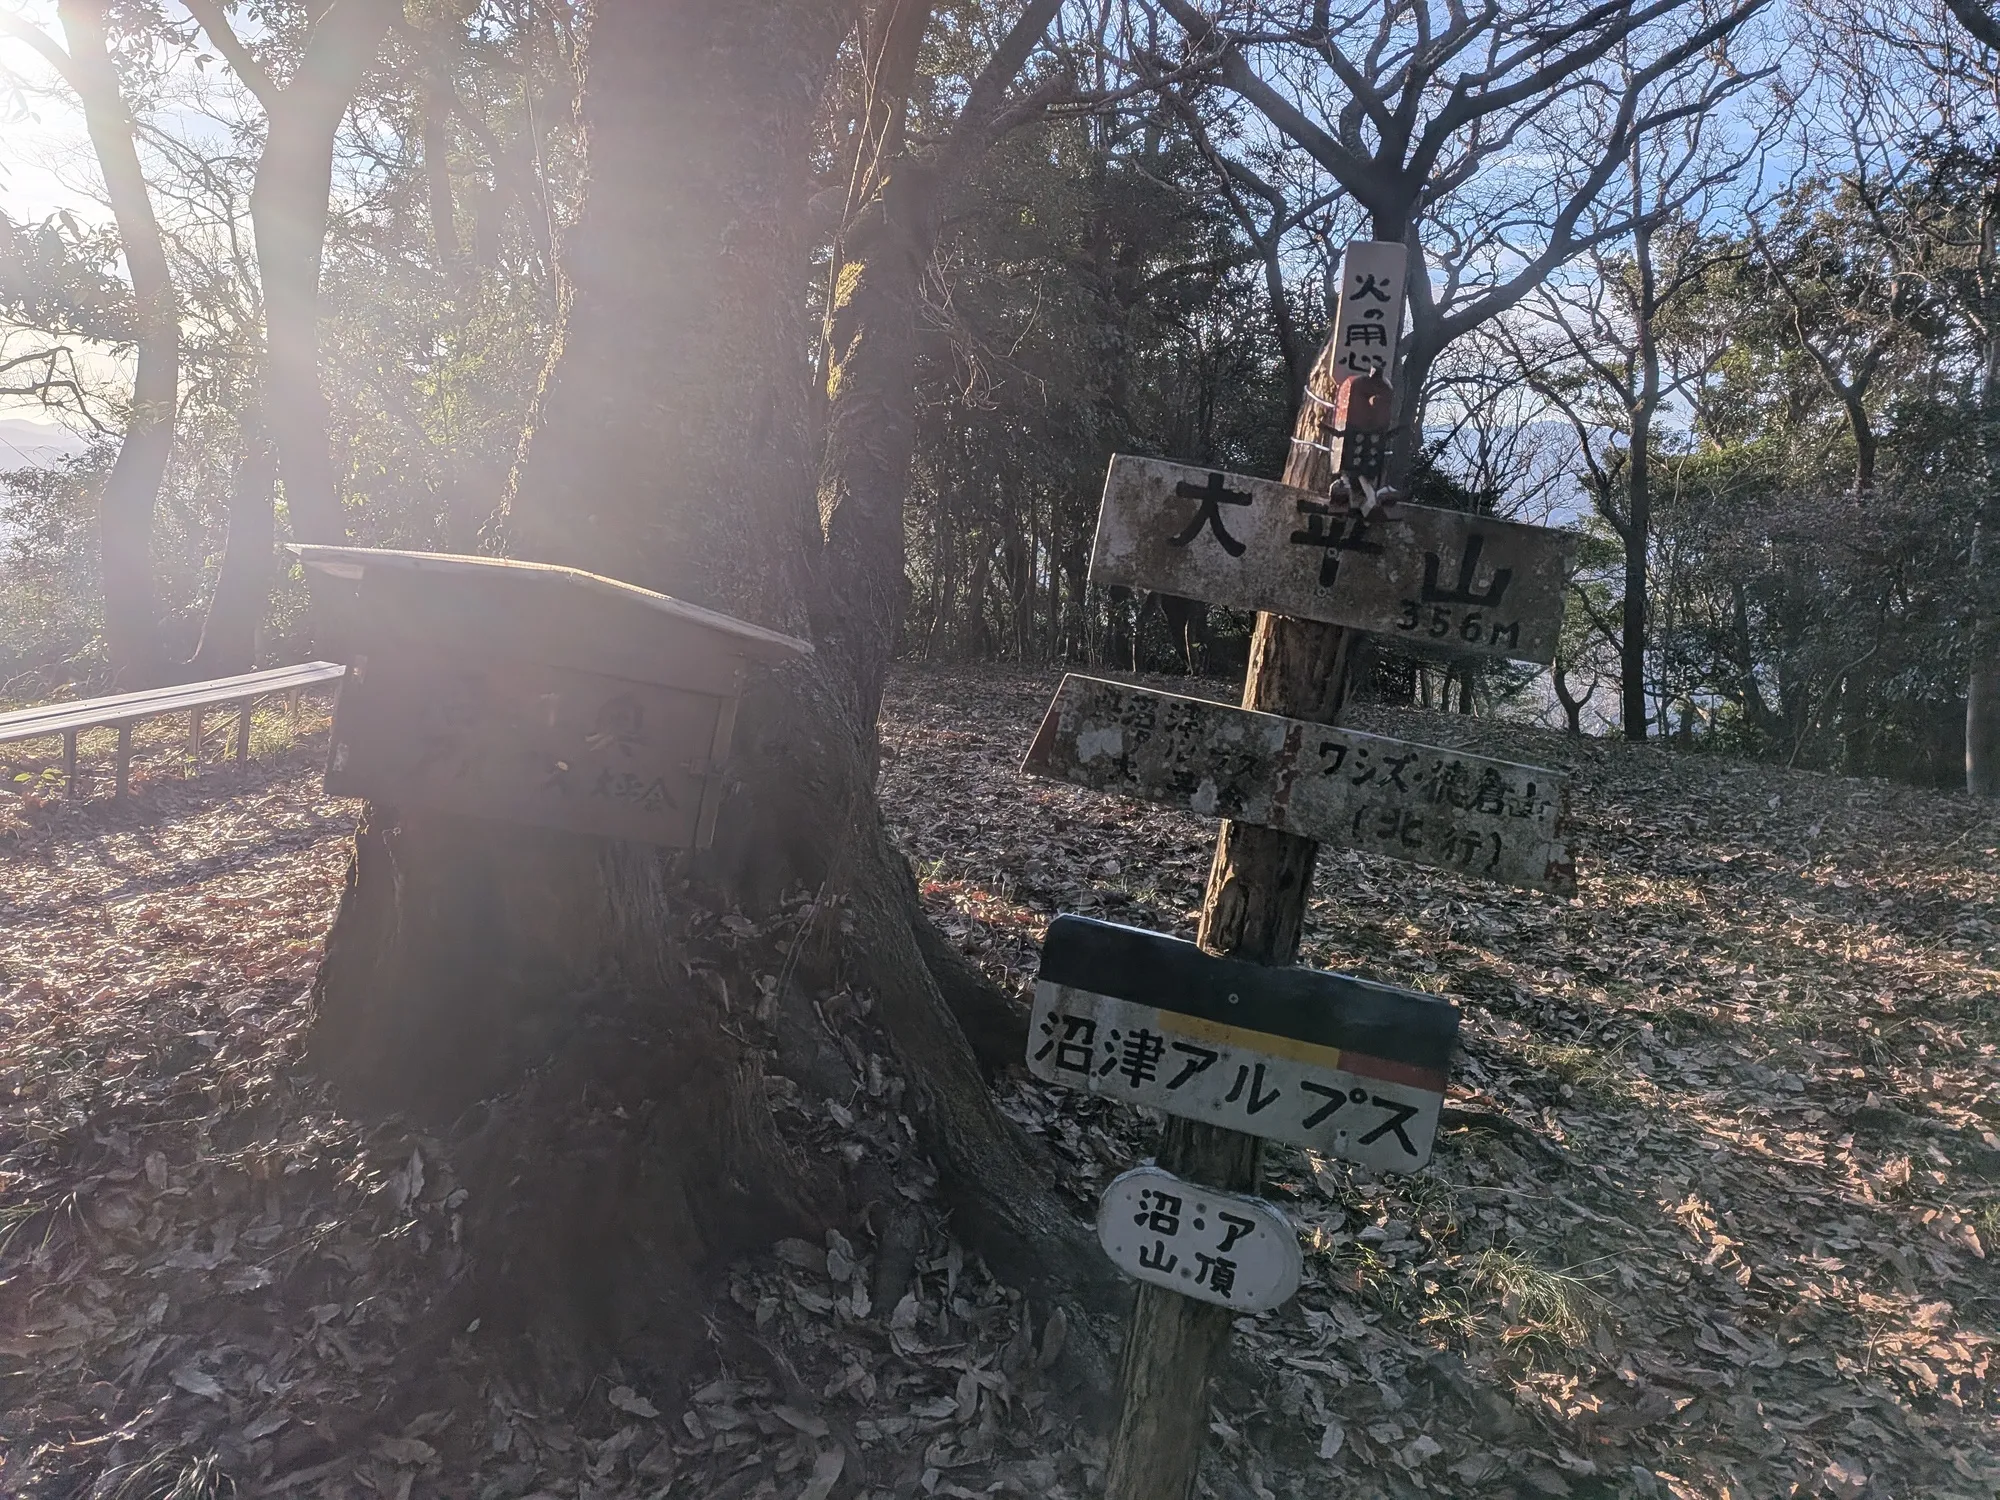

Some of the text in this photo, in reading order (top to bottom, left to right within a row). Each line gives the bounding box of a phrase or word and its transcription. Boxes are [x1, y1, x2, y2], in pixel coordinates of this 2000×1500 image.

[1338, 273, 1391, 373] 火の用心
[1167, 473, 1512, 607] 大平山
[1396, 599, 1520, 649] 356M
[1033, 1011, 1419, 1157] 沼津アルプス
[1138, 1239, 1237, 1299] 山頂
